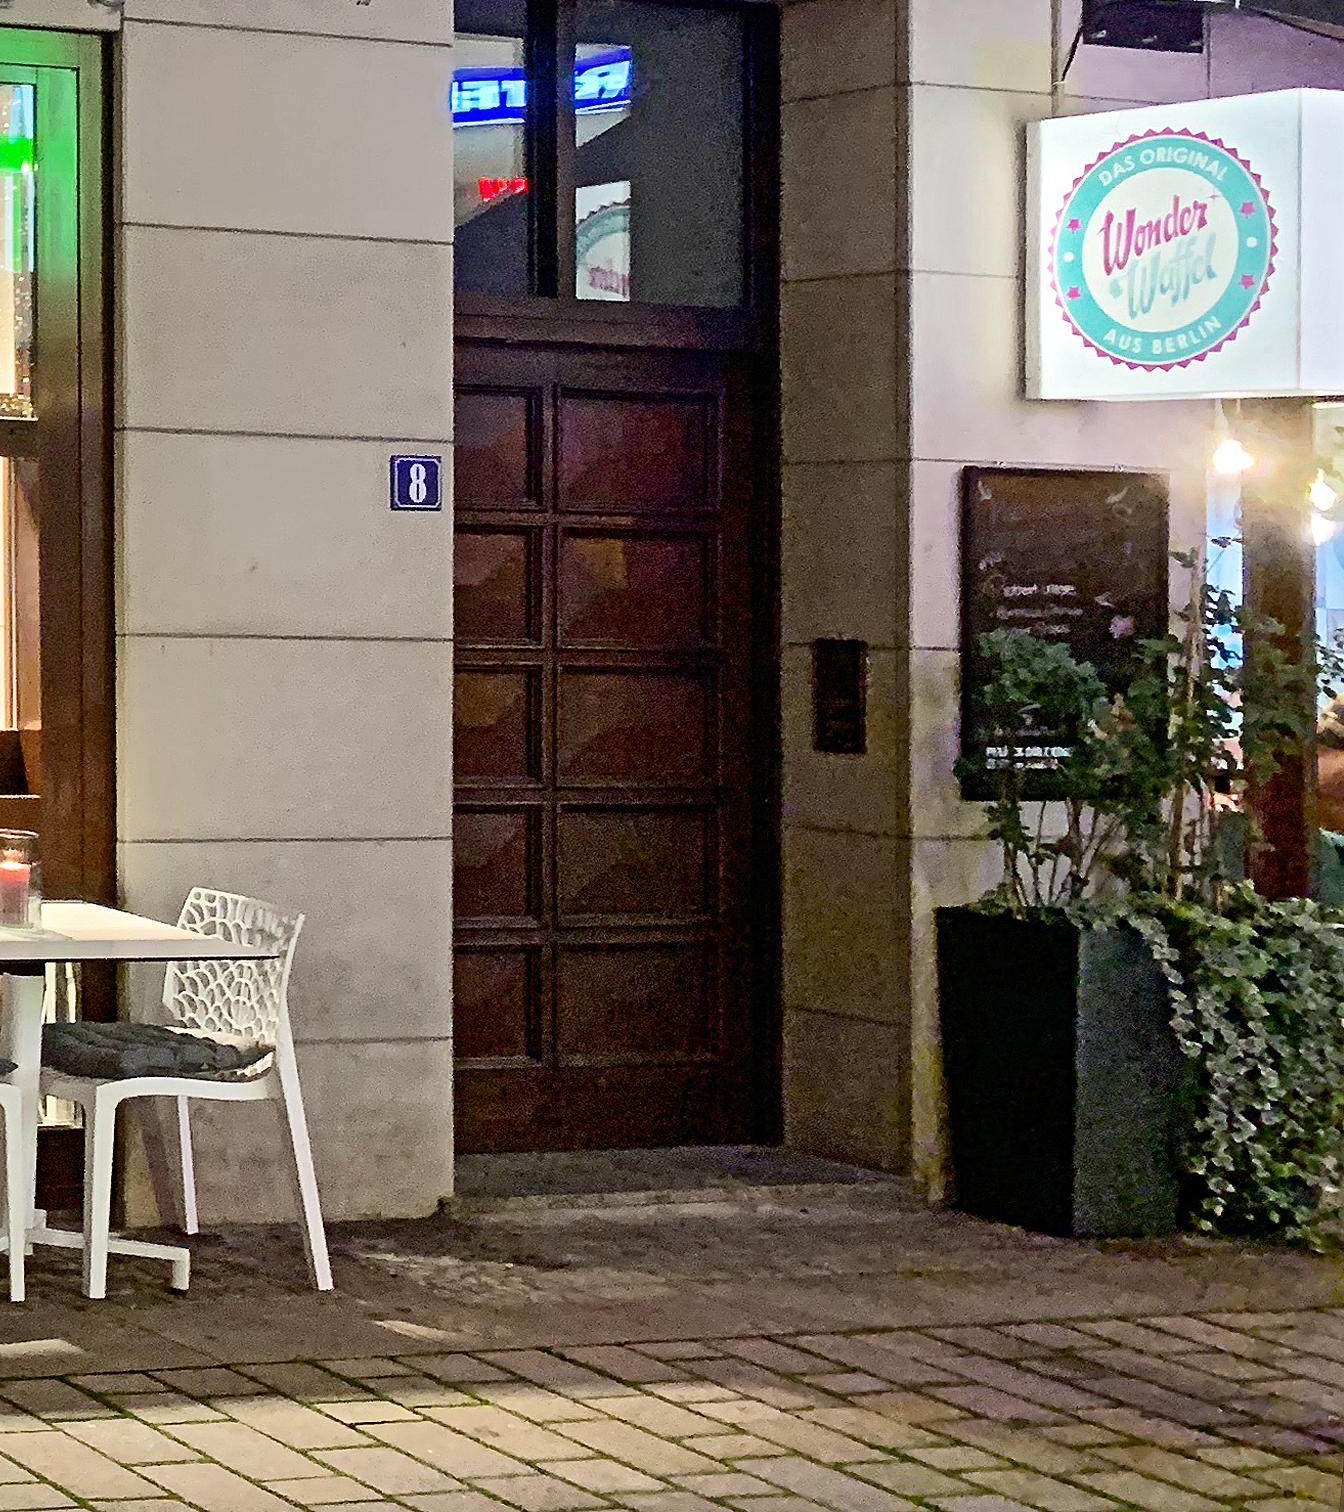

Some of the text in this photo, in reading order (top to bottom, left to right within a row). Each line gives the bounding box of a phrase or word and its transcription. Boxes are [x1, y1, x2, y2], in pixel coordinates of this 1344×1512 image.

[1098, 146, 1229, 186] DAS ORIGINAL
[1097, 194, 1208, 276] Wonder
[1102, 315, 1222, 354] AUS BERLIN
[408, 462, 427, 504] 8
